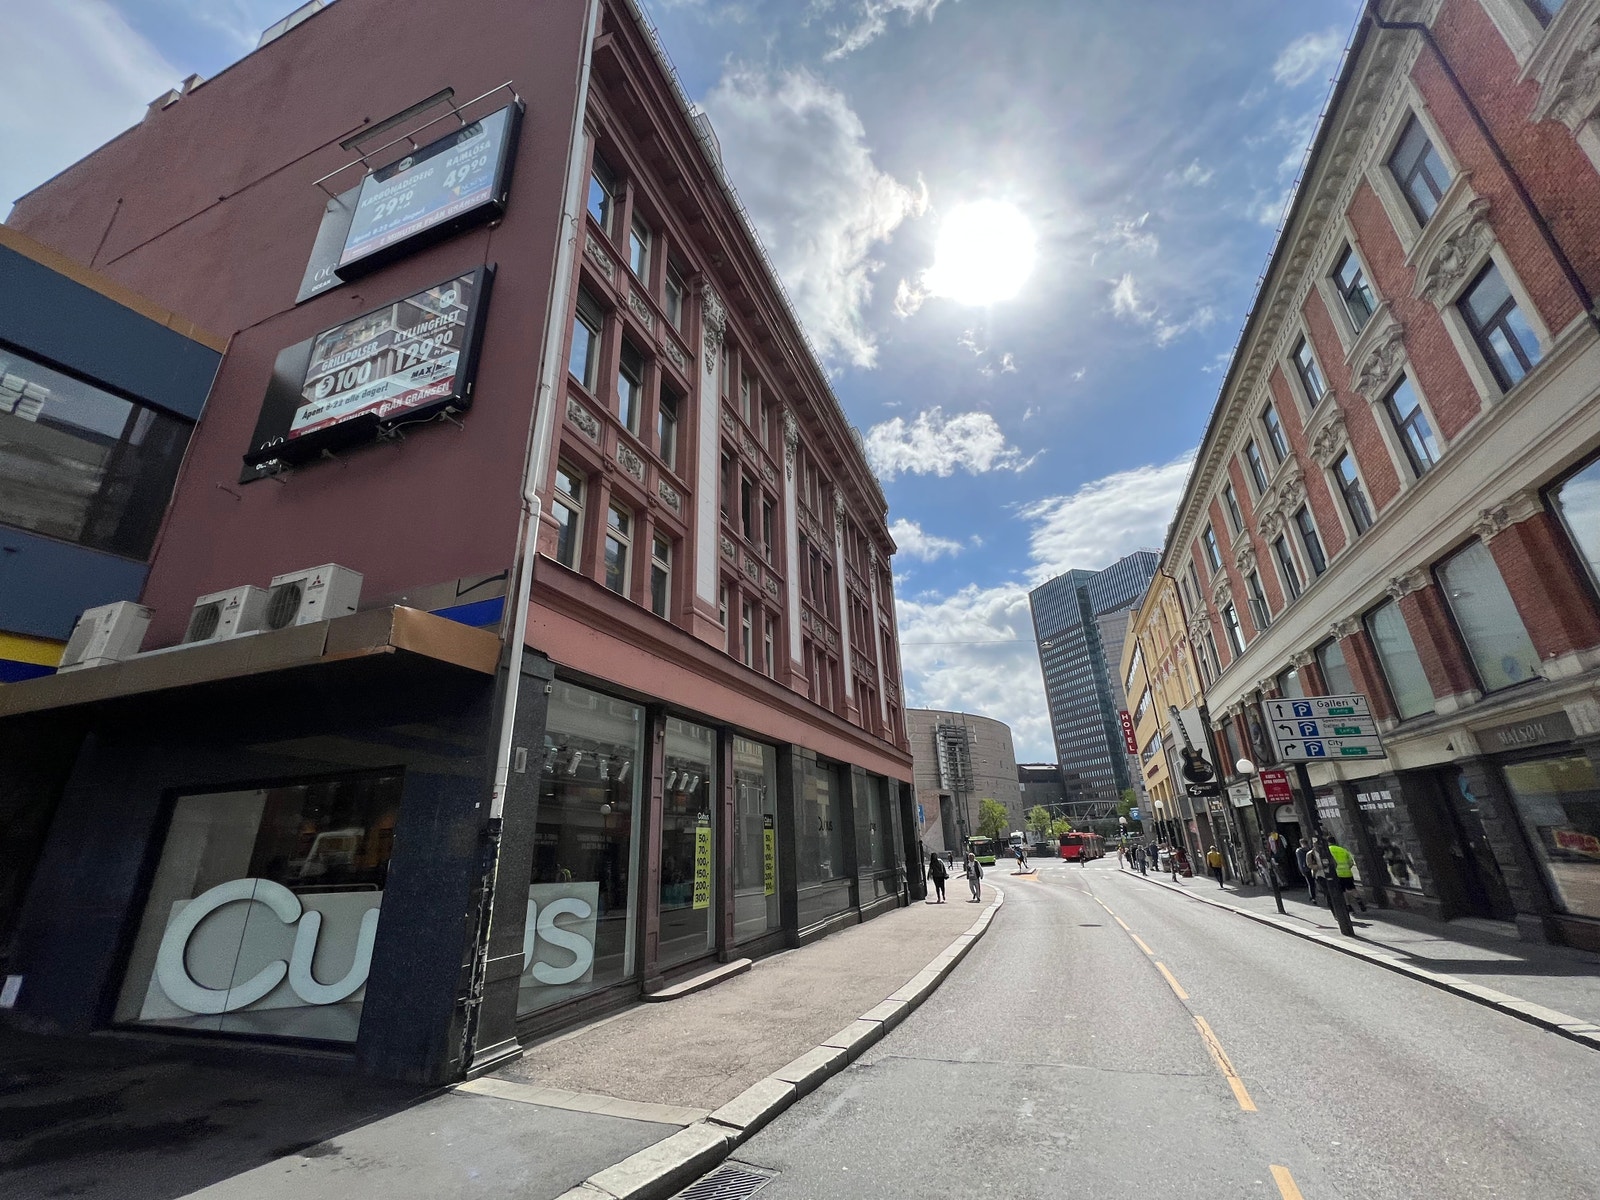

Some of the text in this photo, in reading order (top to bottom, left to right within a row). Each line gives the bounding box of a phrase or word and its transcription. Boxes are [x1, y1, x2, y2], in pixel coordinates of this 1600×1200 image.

[394, 310, 460, 343] KYLLINGFILET
[322, 342, 378, 371] GRILLPØLSER
[336, 362, 372, 392] 100
[302, 407, 324, 420] Åpent
[345, 395, 360, 404] alle
[1317, 700, 1349, 708] Galleri
[1121, 714, 1135, 751] HOTEL
